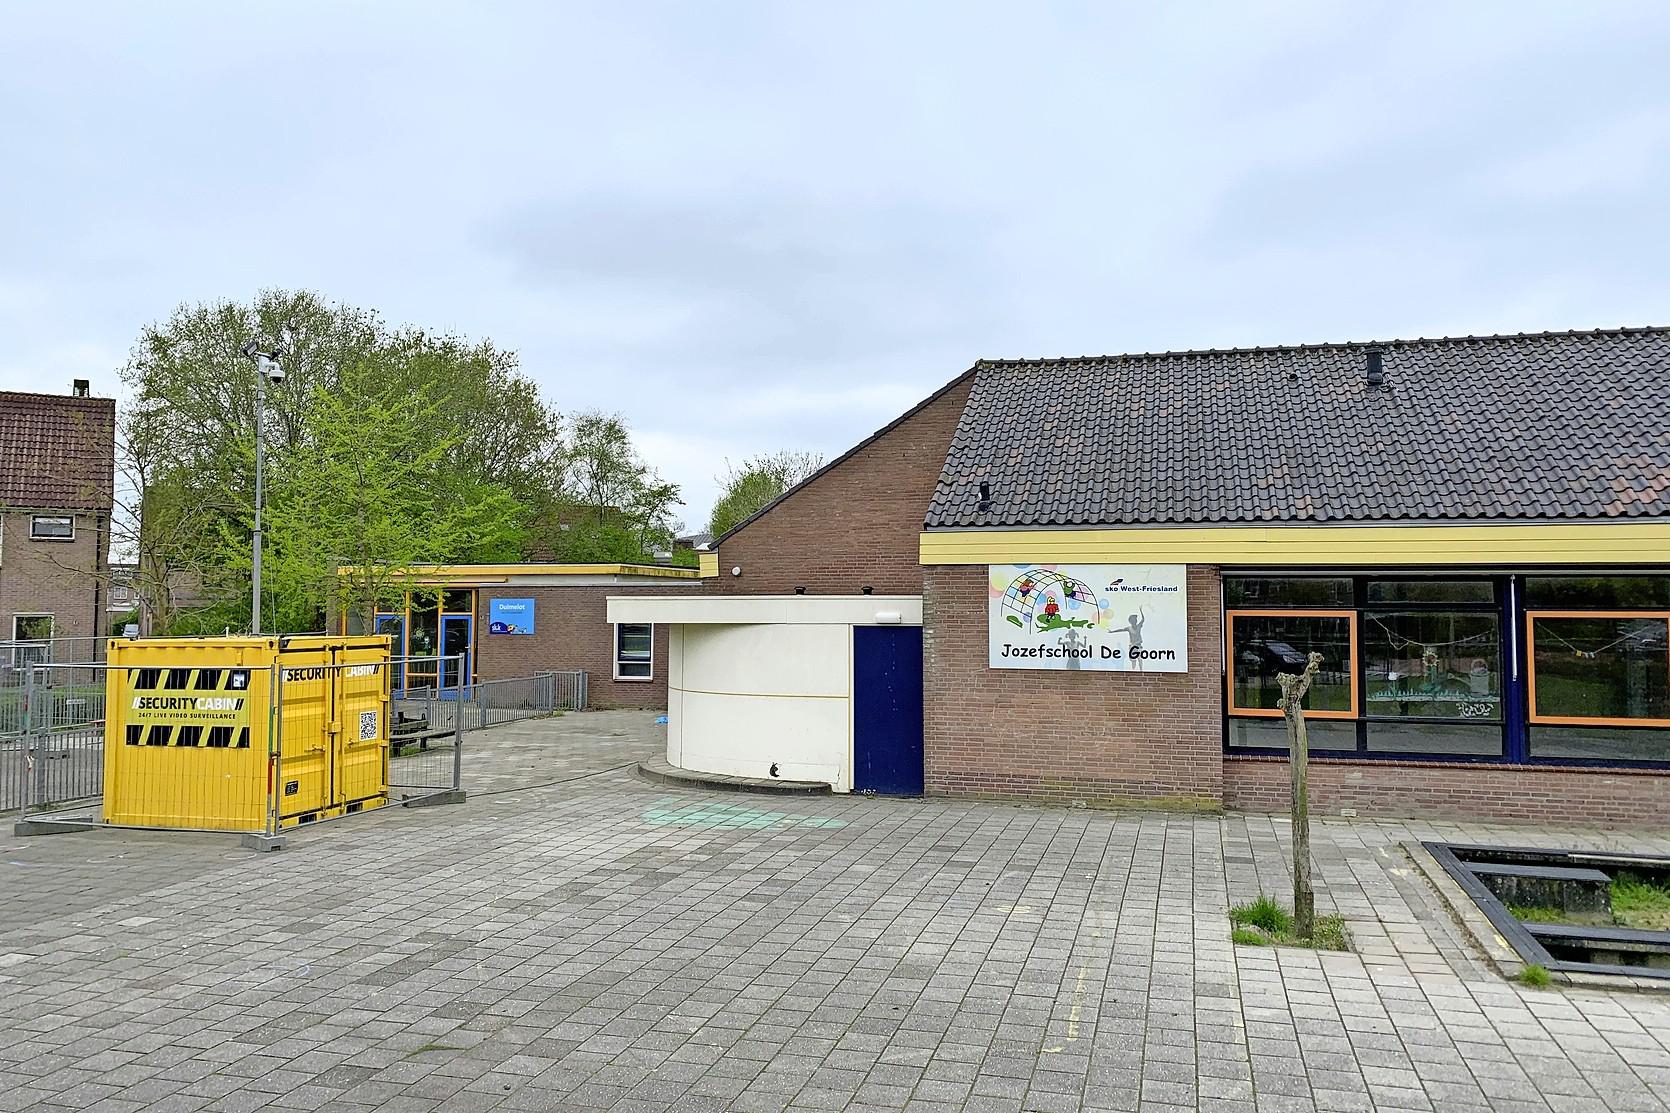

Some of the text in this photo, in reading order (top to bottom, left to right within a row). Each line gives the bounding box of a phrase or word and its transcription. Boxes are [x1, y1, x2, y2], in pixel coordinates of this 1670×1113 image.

[1001, 643, 1176, 661] Jozefschool De Goorn
[189, 712, 237, 720] SURVEILLANCE
